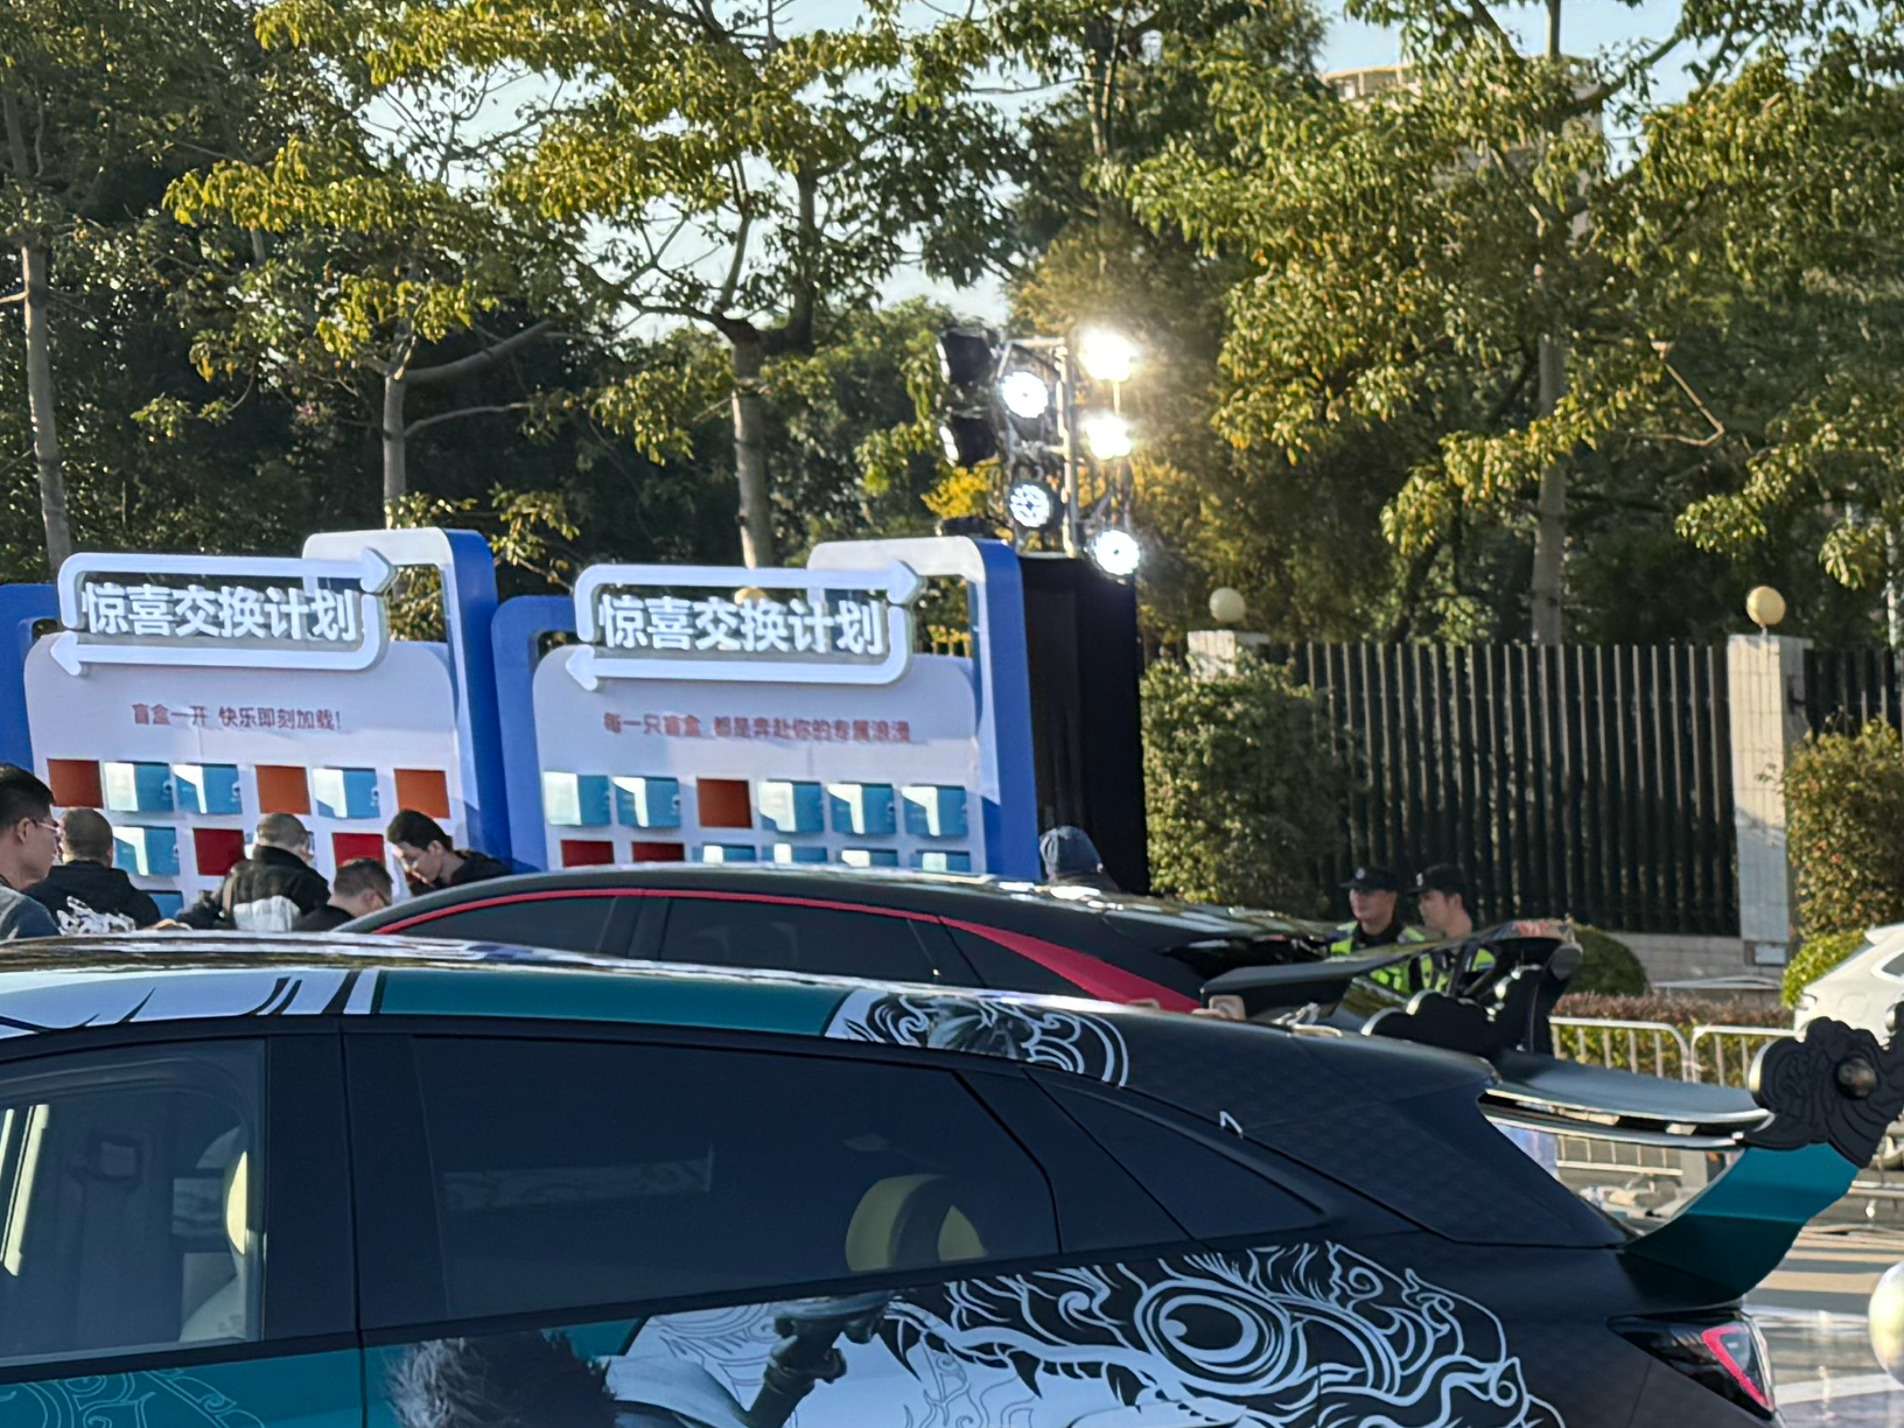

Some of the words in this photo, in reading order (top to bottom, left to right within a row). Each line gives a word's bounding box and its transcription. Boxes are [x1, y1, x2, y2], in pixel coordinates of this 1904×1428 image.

[81, 583, 361, 640] 惊喜交换计划
[601, 596, 881, 655] 惊喜交换计划
